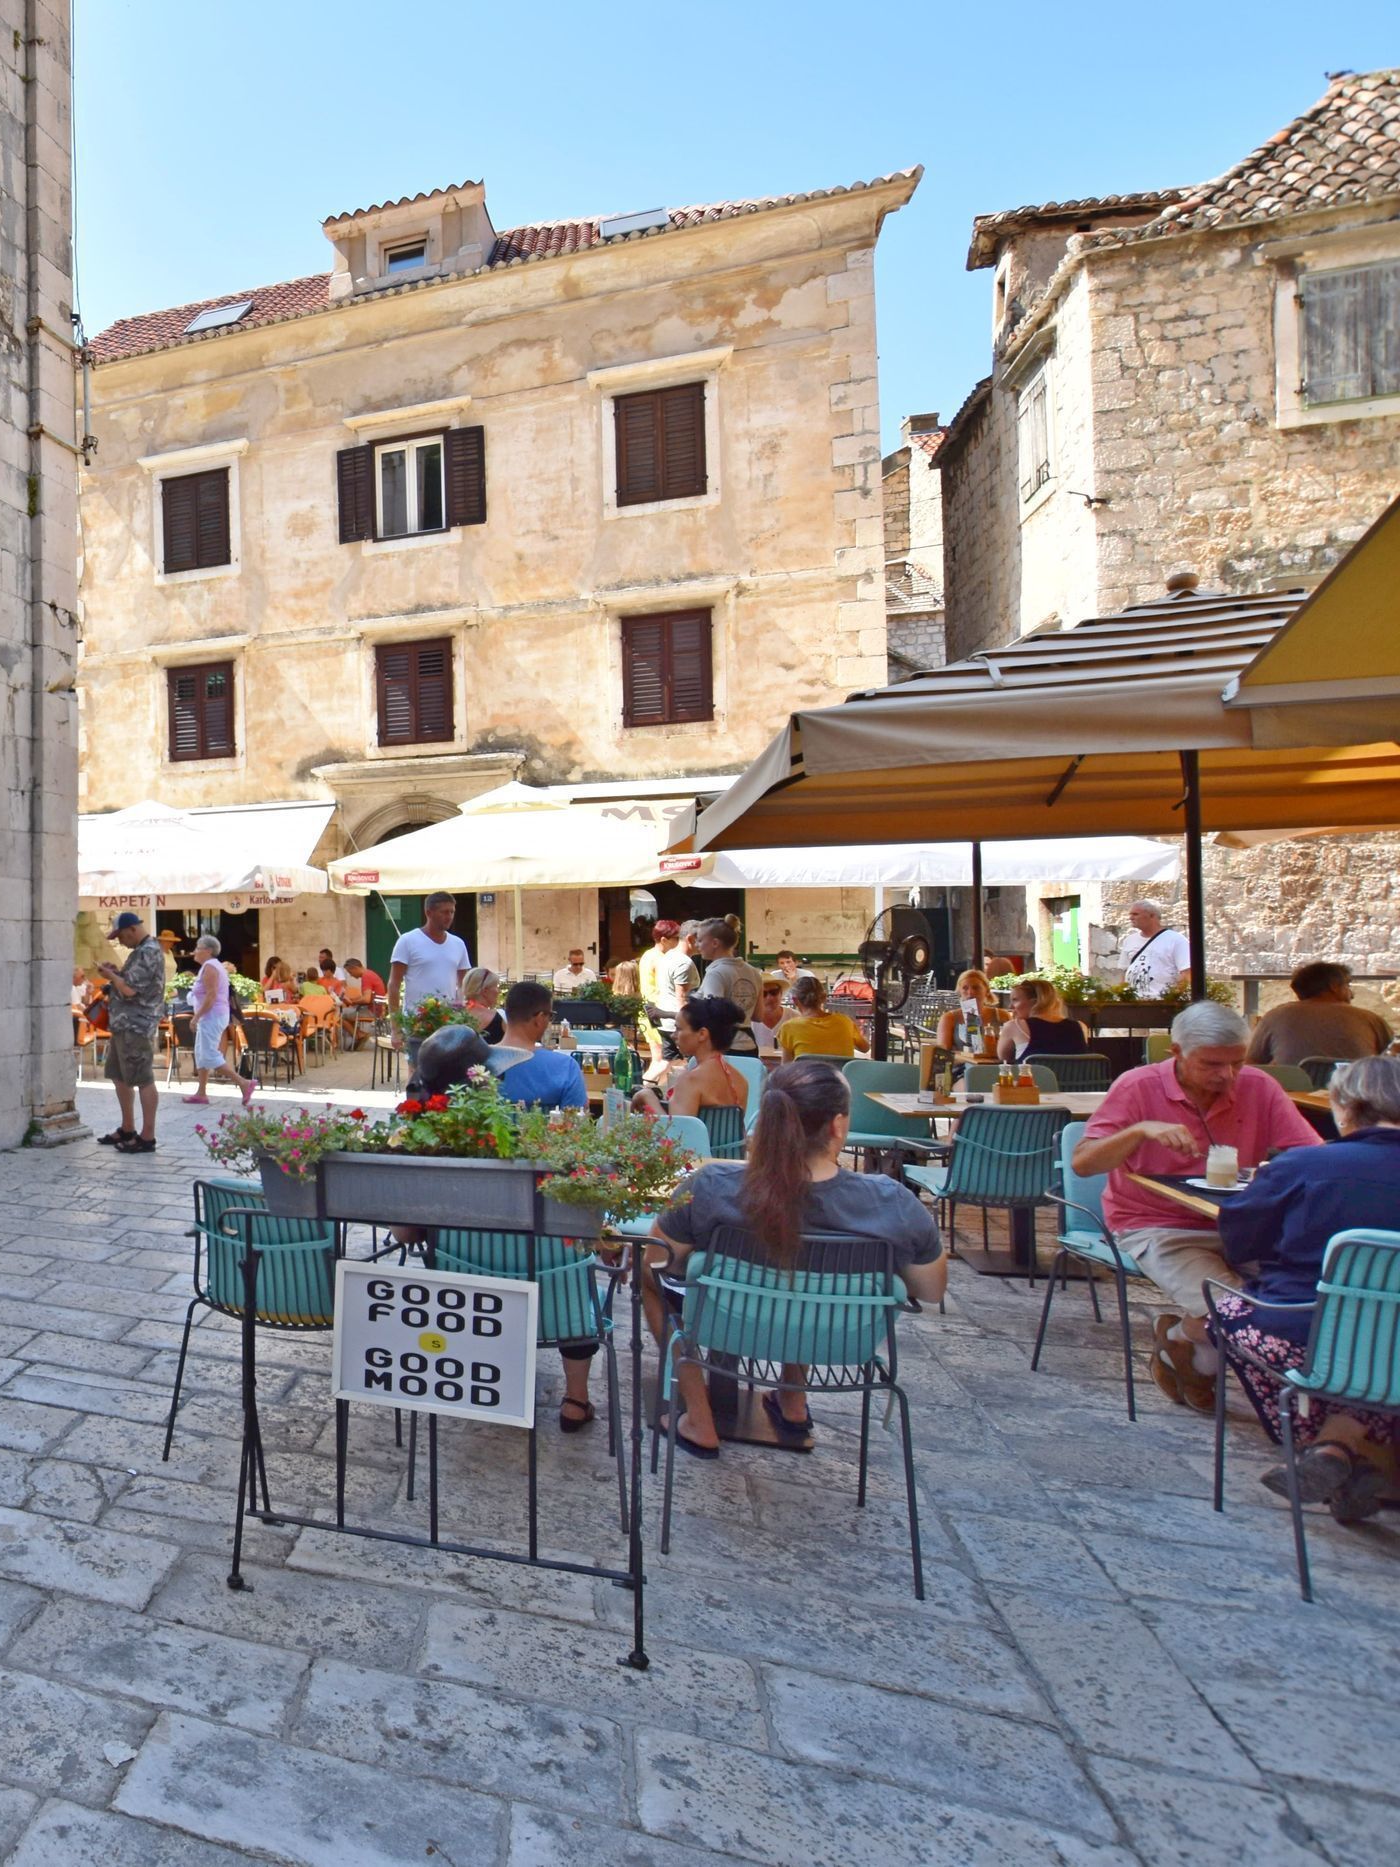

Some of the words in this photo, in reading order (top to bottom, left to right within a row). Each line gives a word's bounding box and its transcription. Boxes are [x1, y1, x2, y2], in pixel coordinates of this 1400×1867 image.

[367, 1280, 503, 1314] GOOD
[368, 1303, 502, 1337] FOOD
[365, 1347, 501, 1384] GOOD
[364, 1369, 500, 1407] MOOD
